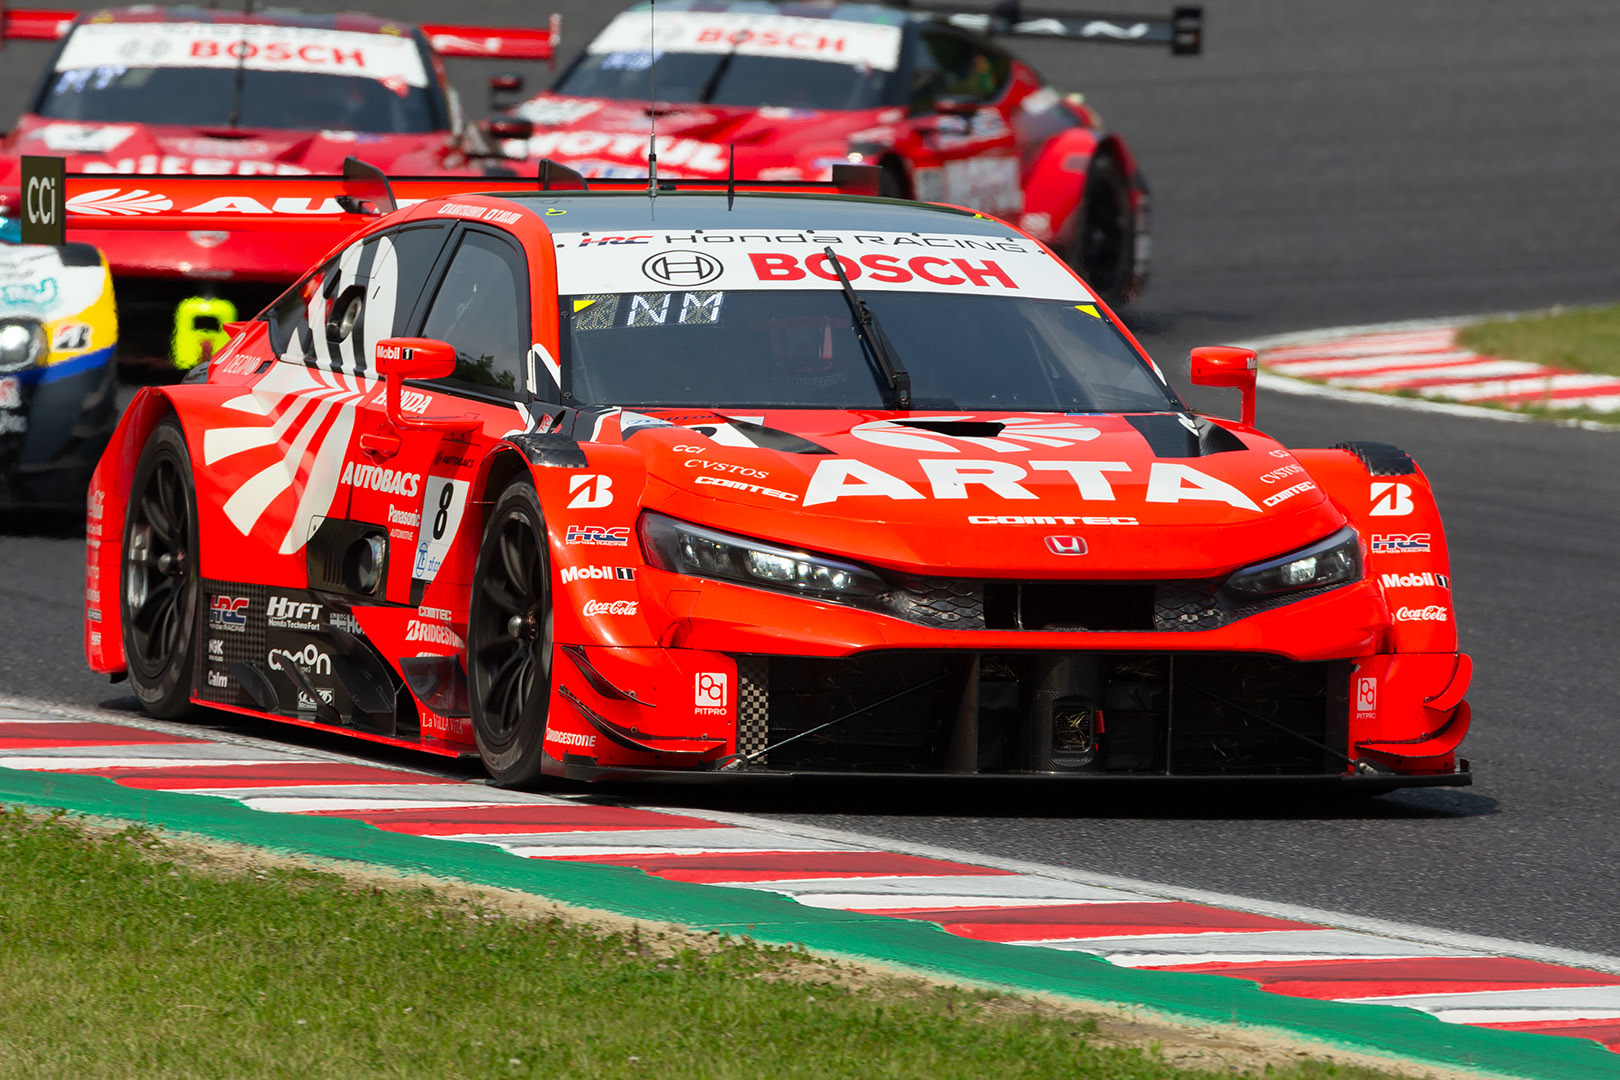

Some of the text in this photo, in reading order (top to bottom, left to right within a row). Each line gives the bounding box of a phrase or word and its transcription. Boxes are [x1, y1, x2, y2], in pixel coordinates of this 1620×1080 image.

[696, 27, 846, 52] BOSCH
[188, 40, 366, 68] BOSCH
[578, 233, 1029, 254] HRC Honda RACING
[748, 252, 1021, 290] BOSCH
[376, 346, 413, 360] Mobil 1
[371, 387, 433, 414] HNDA
[441, 455, 475, 468] AUTOBACS
[683, 459, 770, 479] CVSTOS
[340, 461, 421, 498] AUTOBACS
[694, 476, 799, 502] COMTEC
[802, 458, 1263, 513] ARTA
[1262, 480, 1317, 507] COMTEC
[388, 503, 421, 528] Panasonic
[433, 482, 455, 540] 8
[967, 515, 1140, 526] COMTEC
[566, 525, 631, 542] HRC
[1372, 533, 1431, 550] HRC
[560, 565, 634, 585] Mobil 1
[1381, 572, 1436, 588] Mobil
[209, 594, 250, 626] HRC
[418, 606, 452, 621] COMTEC
[582, 599, 639, 617] Coca-Cola
[1396, 605, 1448, 622] Coca-Cola
[405, 620, 465, 649] BRIDGESTONE
[208, 639, 224, 655] NGK
[207, 670, 228, 688] Calm
[422, 712, 433, 728] La
[694, 707, 728, 716] PITPRO
[1356, 712, 1376, 720] PITPRO
[545, 727, 597, 748] BRIDGESTONE
